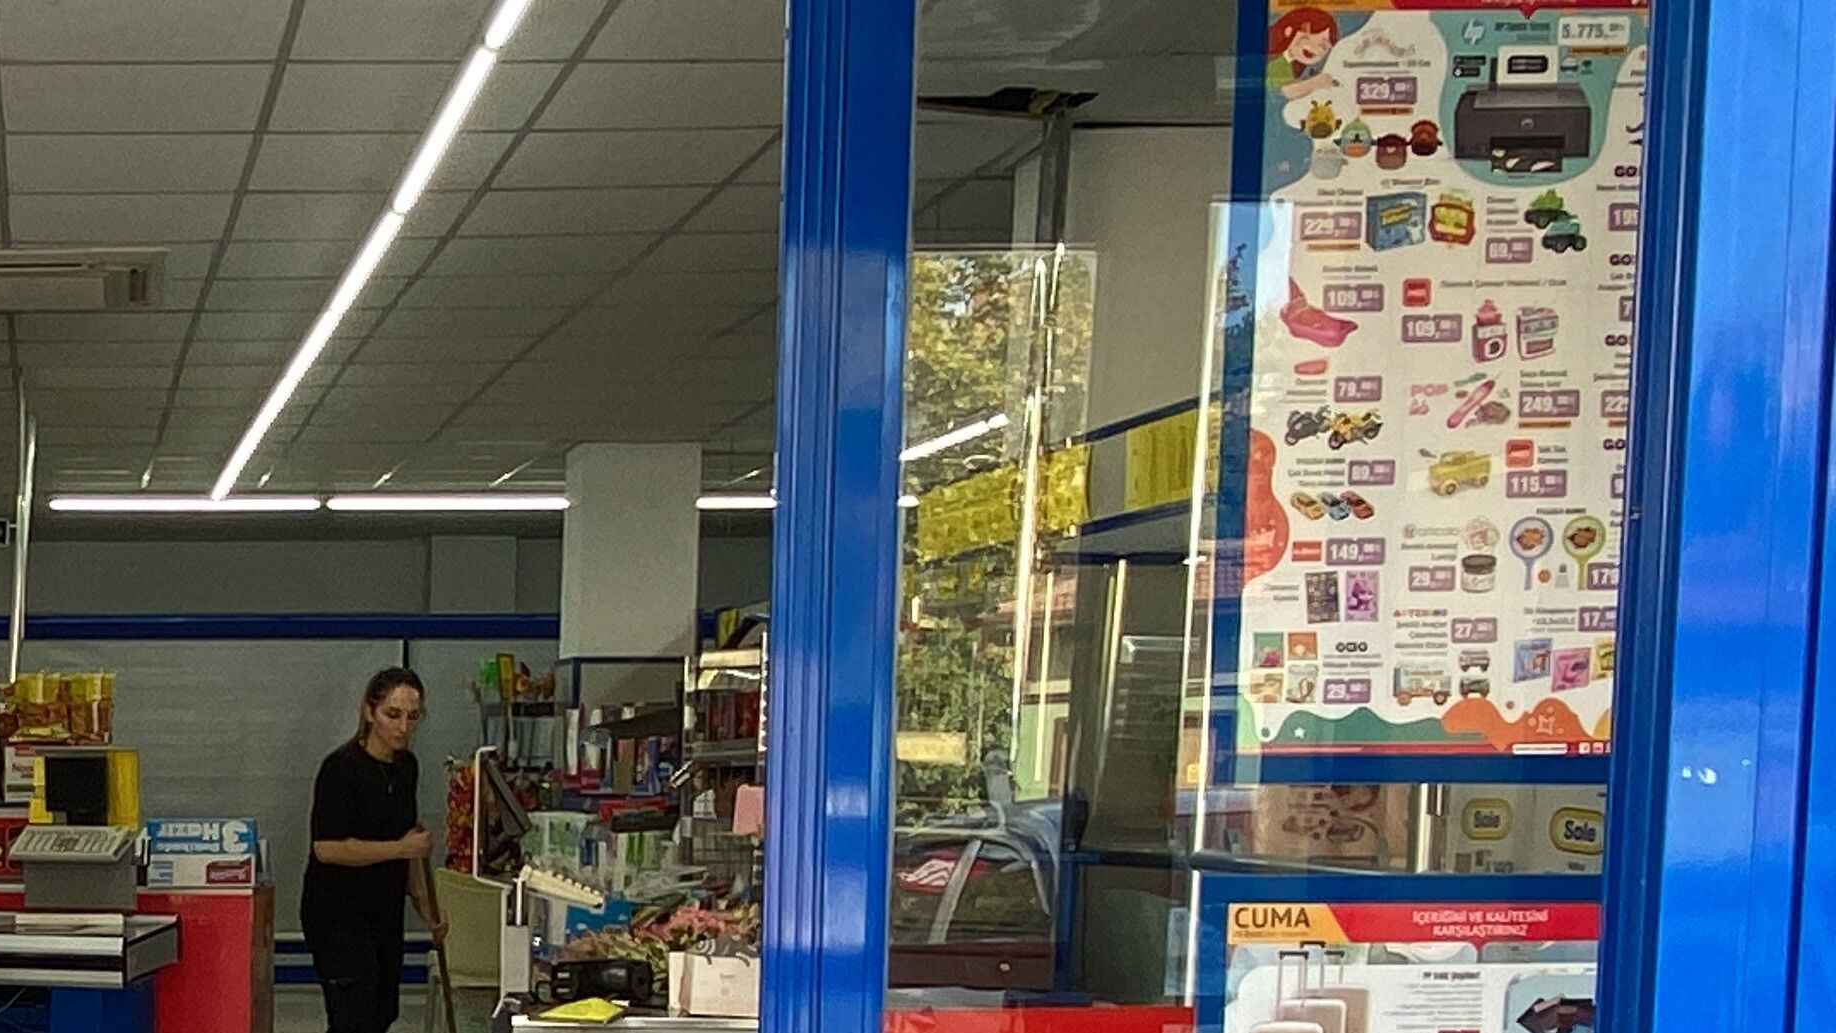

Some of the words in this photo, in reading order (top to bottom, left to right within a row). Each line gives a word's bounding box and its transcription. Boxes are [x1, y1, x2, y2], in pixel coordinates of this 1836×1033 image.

[1564, 819, 1597, 843] Sole
[1235, 907, 1311, 929] CUMA
[1468, 910, 1484, 923] VE
